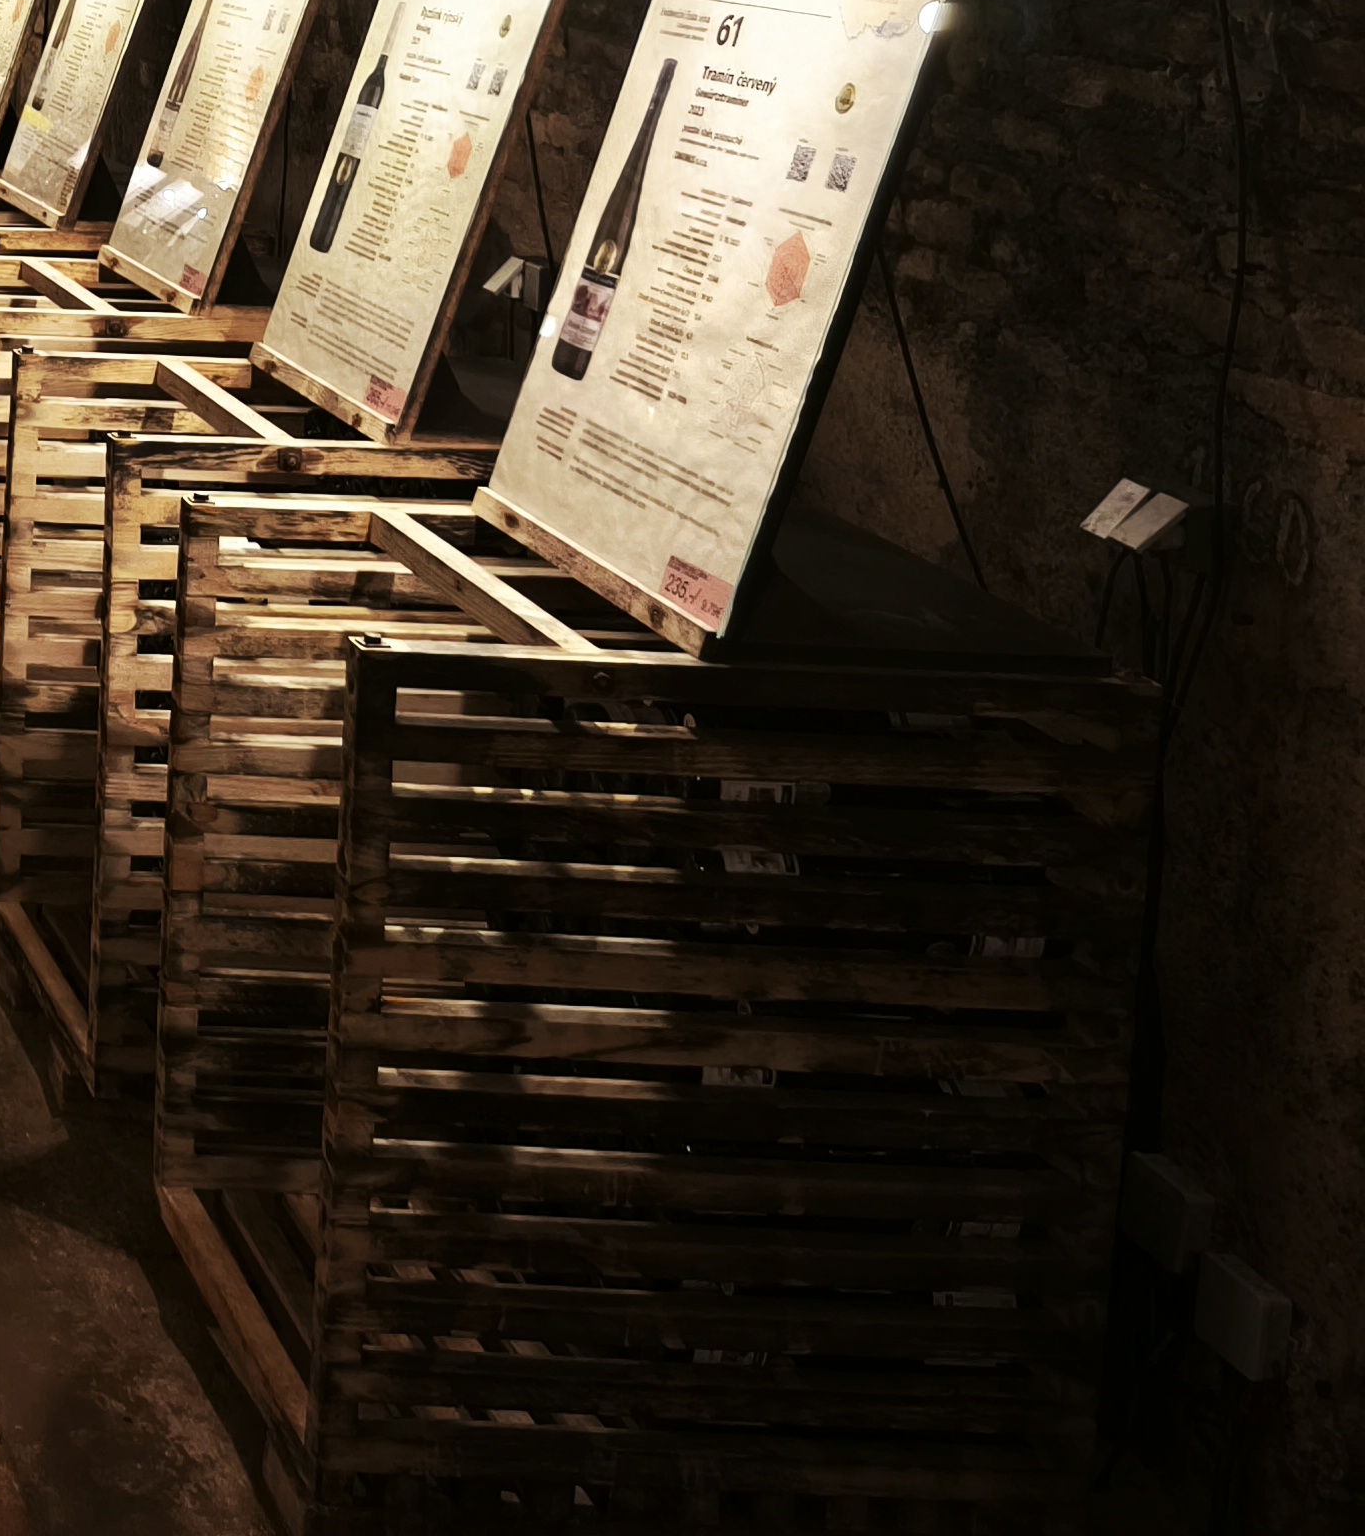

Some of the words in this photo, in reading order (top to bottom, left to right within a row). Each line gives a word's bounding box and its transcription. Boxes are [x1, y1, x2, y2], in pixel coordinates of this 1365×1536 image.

[716, 14, 745, 47] 61
[702, 65, 735, 85] Tramín
[736, 70, 777, 96] červený
